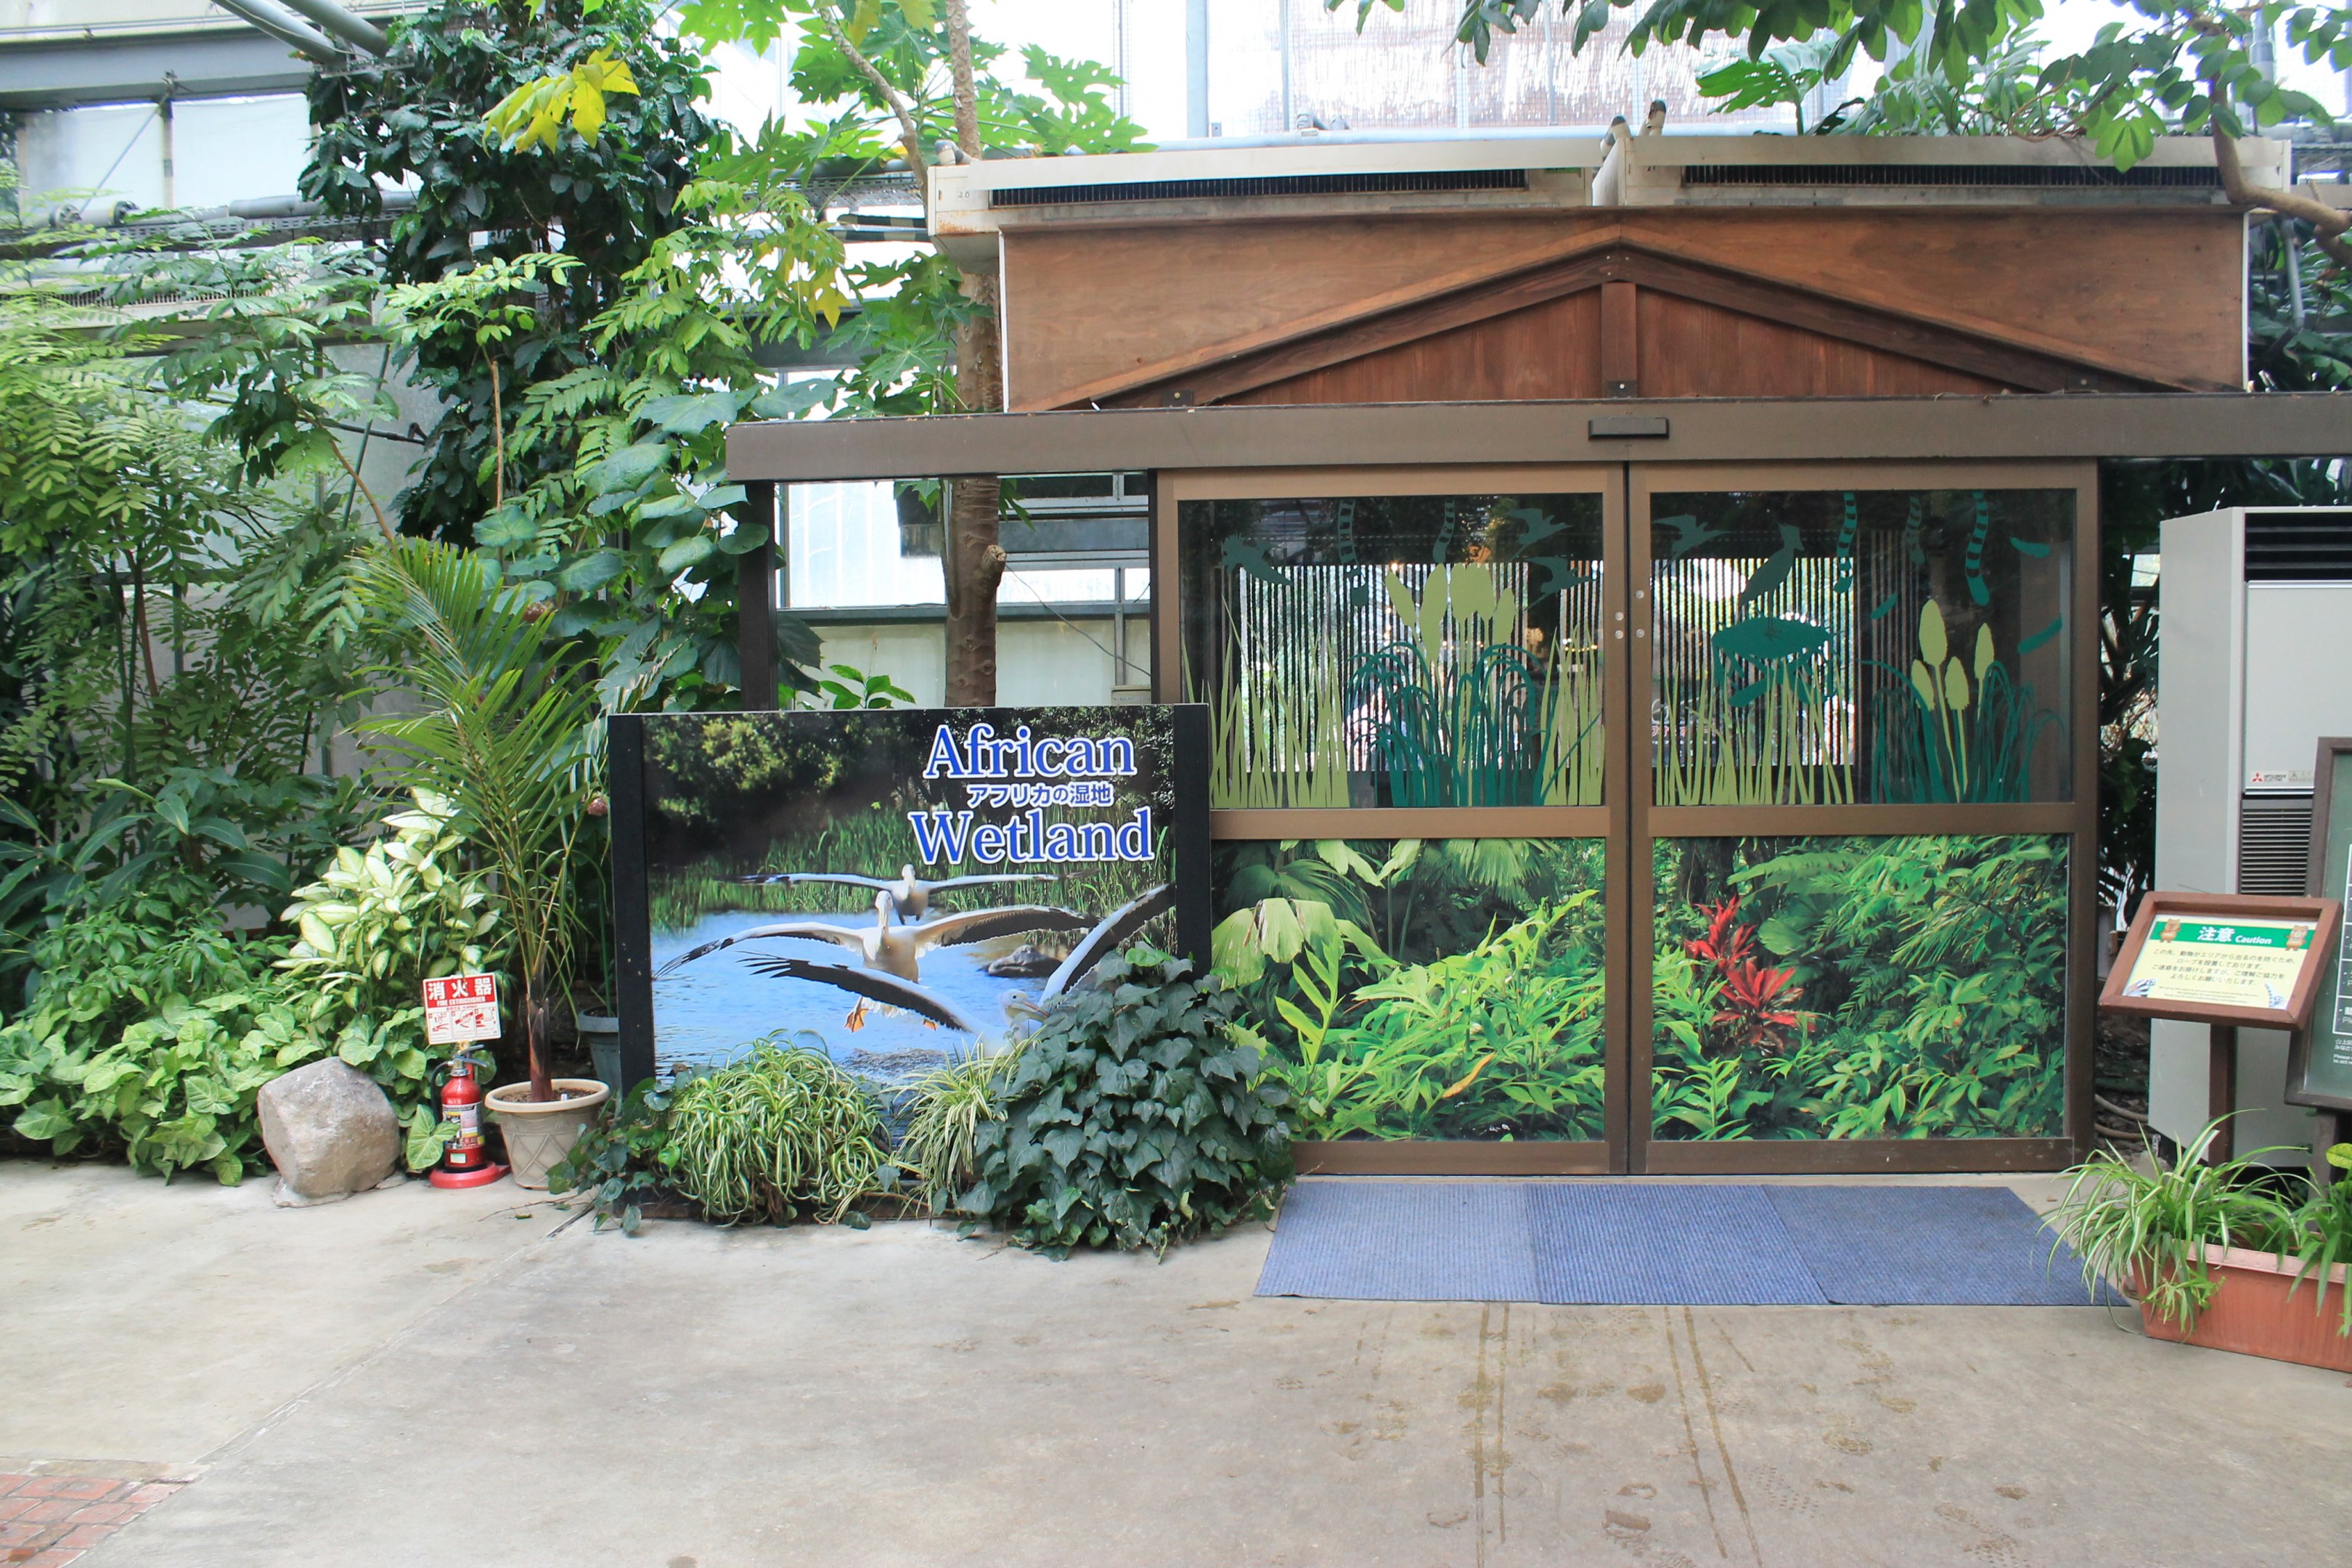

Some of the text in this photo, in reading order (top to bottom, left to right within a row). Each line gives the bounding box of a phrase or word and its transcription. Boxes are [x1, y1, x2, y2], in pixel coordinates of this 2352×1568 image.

[923, 723, 1138, 779] African
[966, 781, 1114, 809] アフリカの湿地
[907, 806, 1155, 865] Wetland
[2197, 926, 2272, 944] 注意 Caution
[428, 978, 492, 1000] 消火器
[449, 996, 486, 1005] EXTINGUISHER
